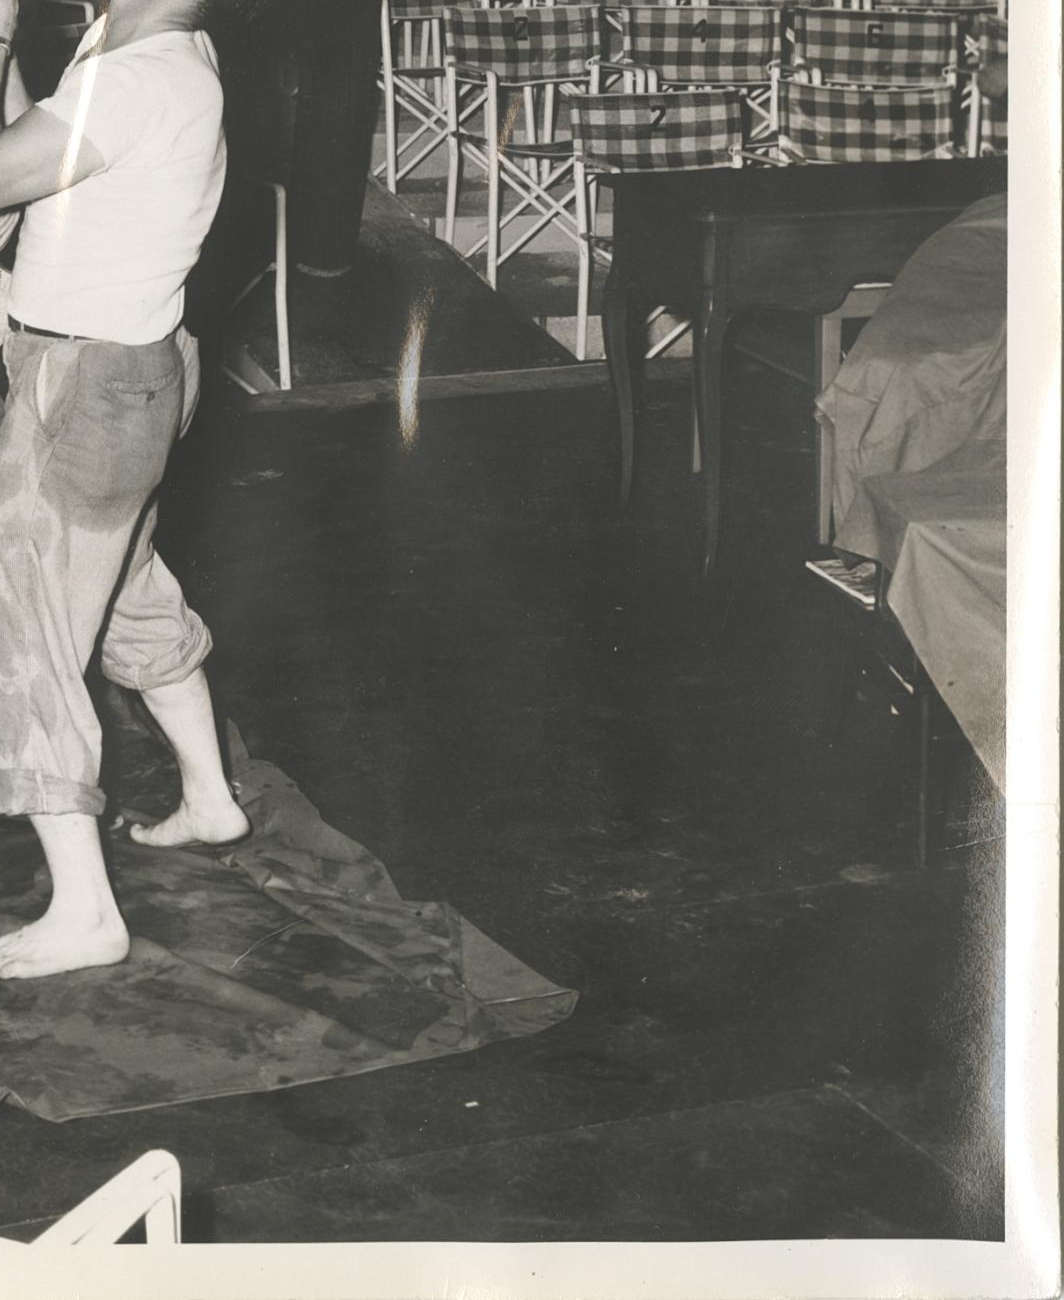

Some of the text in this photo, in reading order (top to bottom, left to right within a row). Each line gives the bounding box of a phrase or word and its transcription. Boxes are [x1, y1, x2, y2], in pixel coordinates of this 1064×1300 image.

[513, 17, 529, 40] 2
[691, 19, 707, 43] 4
[868, 24, 883, 47] 6
[649, 105, 667, 130] 2
